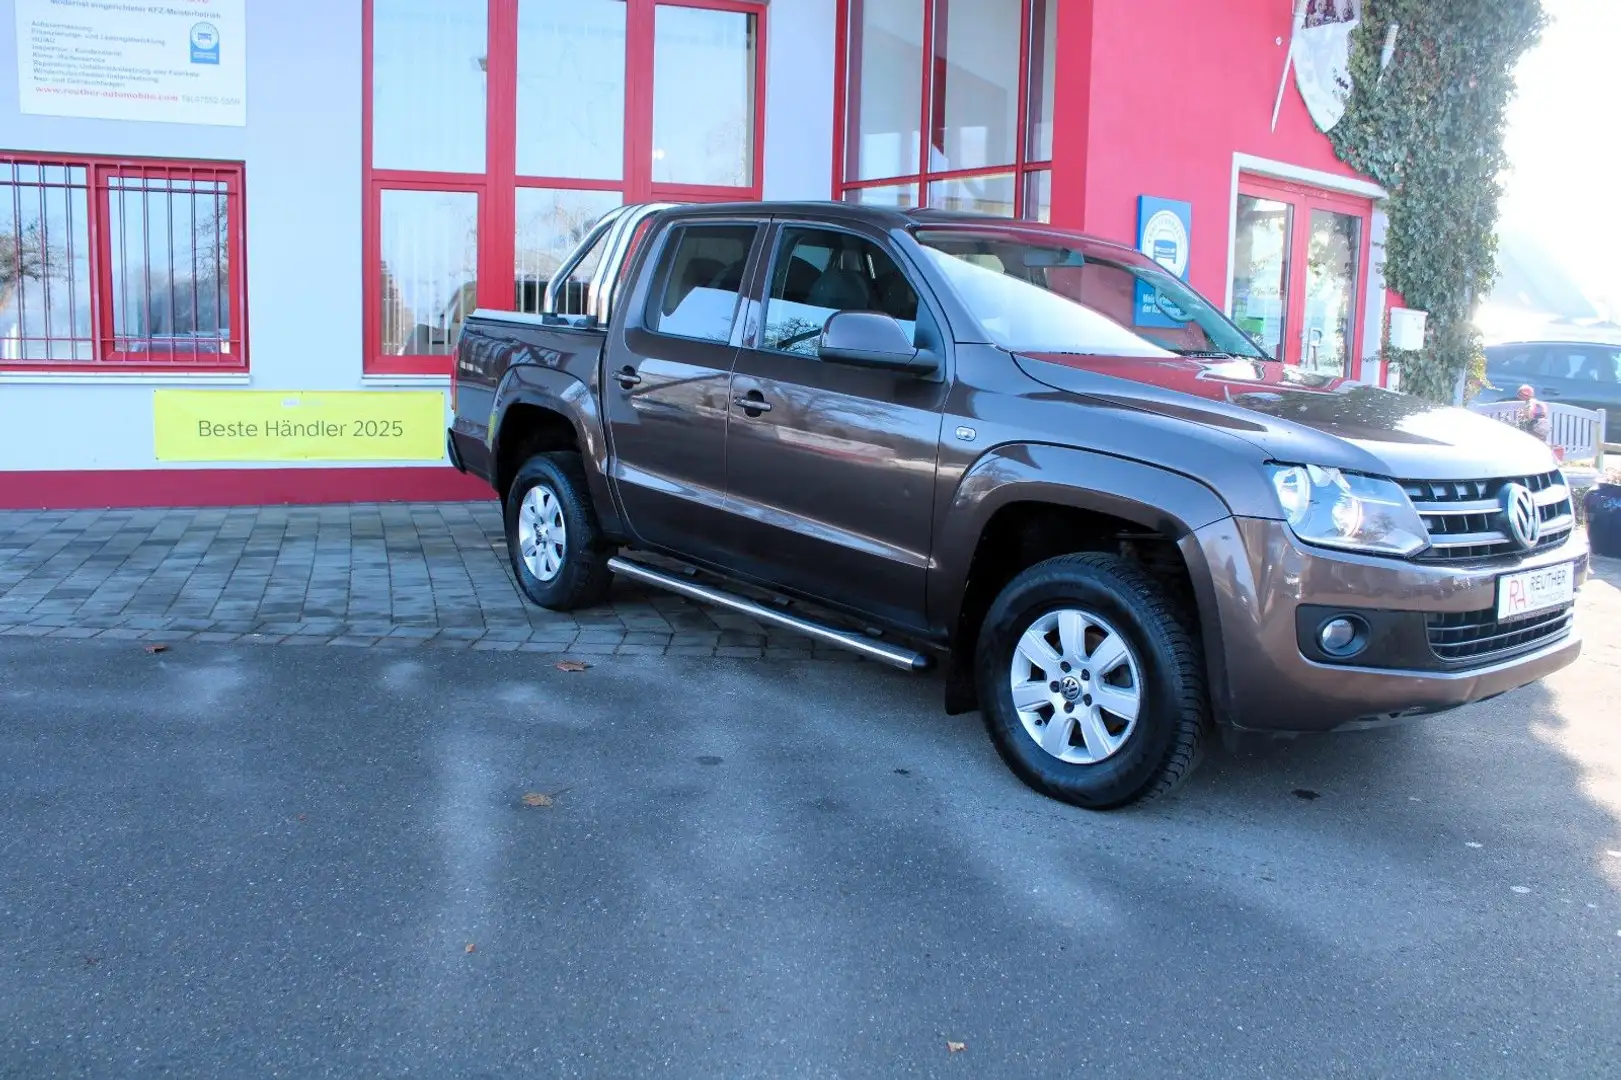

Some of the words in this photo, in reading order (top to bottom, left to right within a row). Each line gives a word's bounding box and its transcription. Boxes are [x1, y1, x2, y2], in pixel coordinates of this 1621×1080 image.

[198, 419, 258, 437] Beste
[265, 419, 347, 437] Händler
[353, 420, 404, 437] 2025
[1530, 569, 1566, 592] REUTHER
